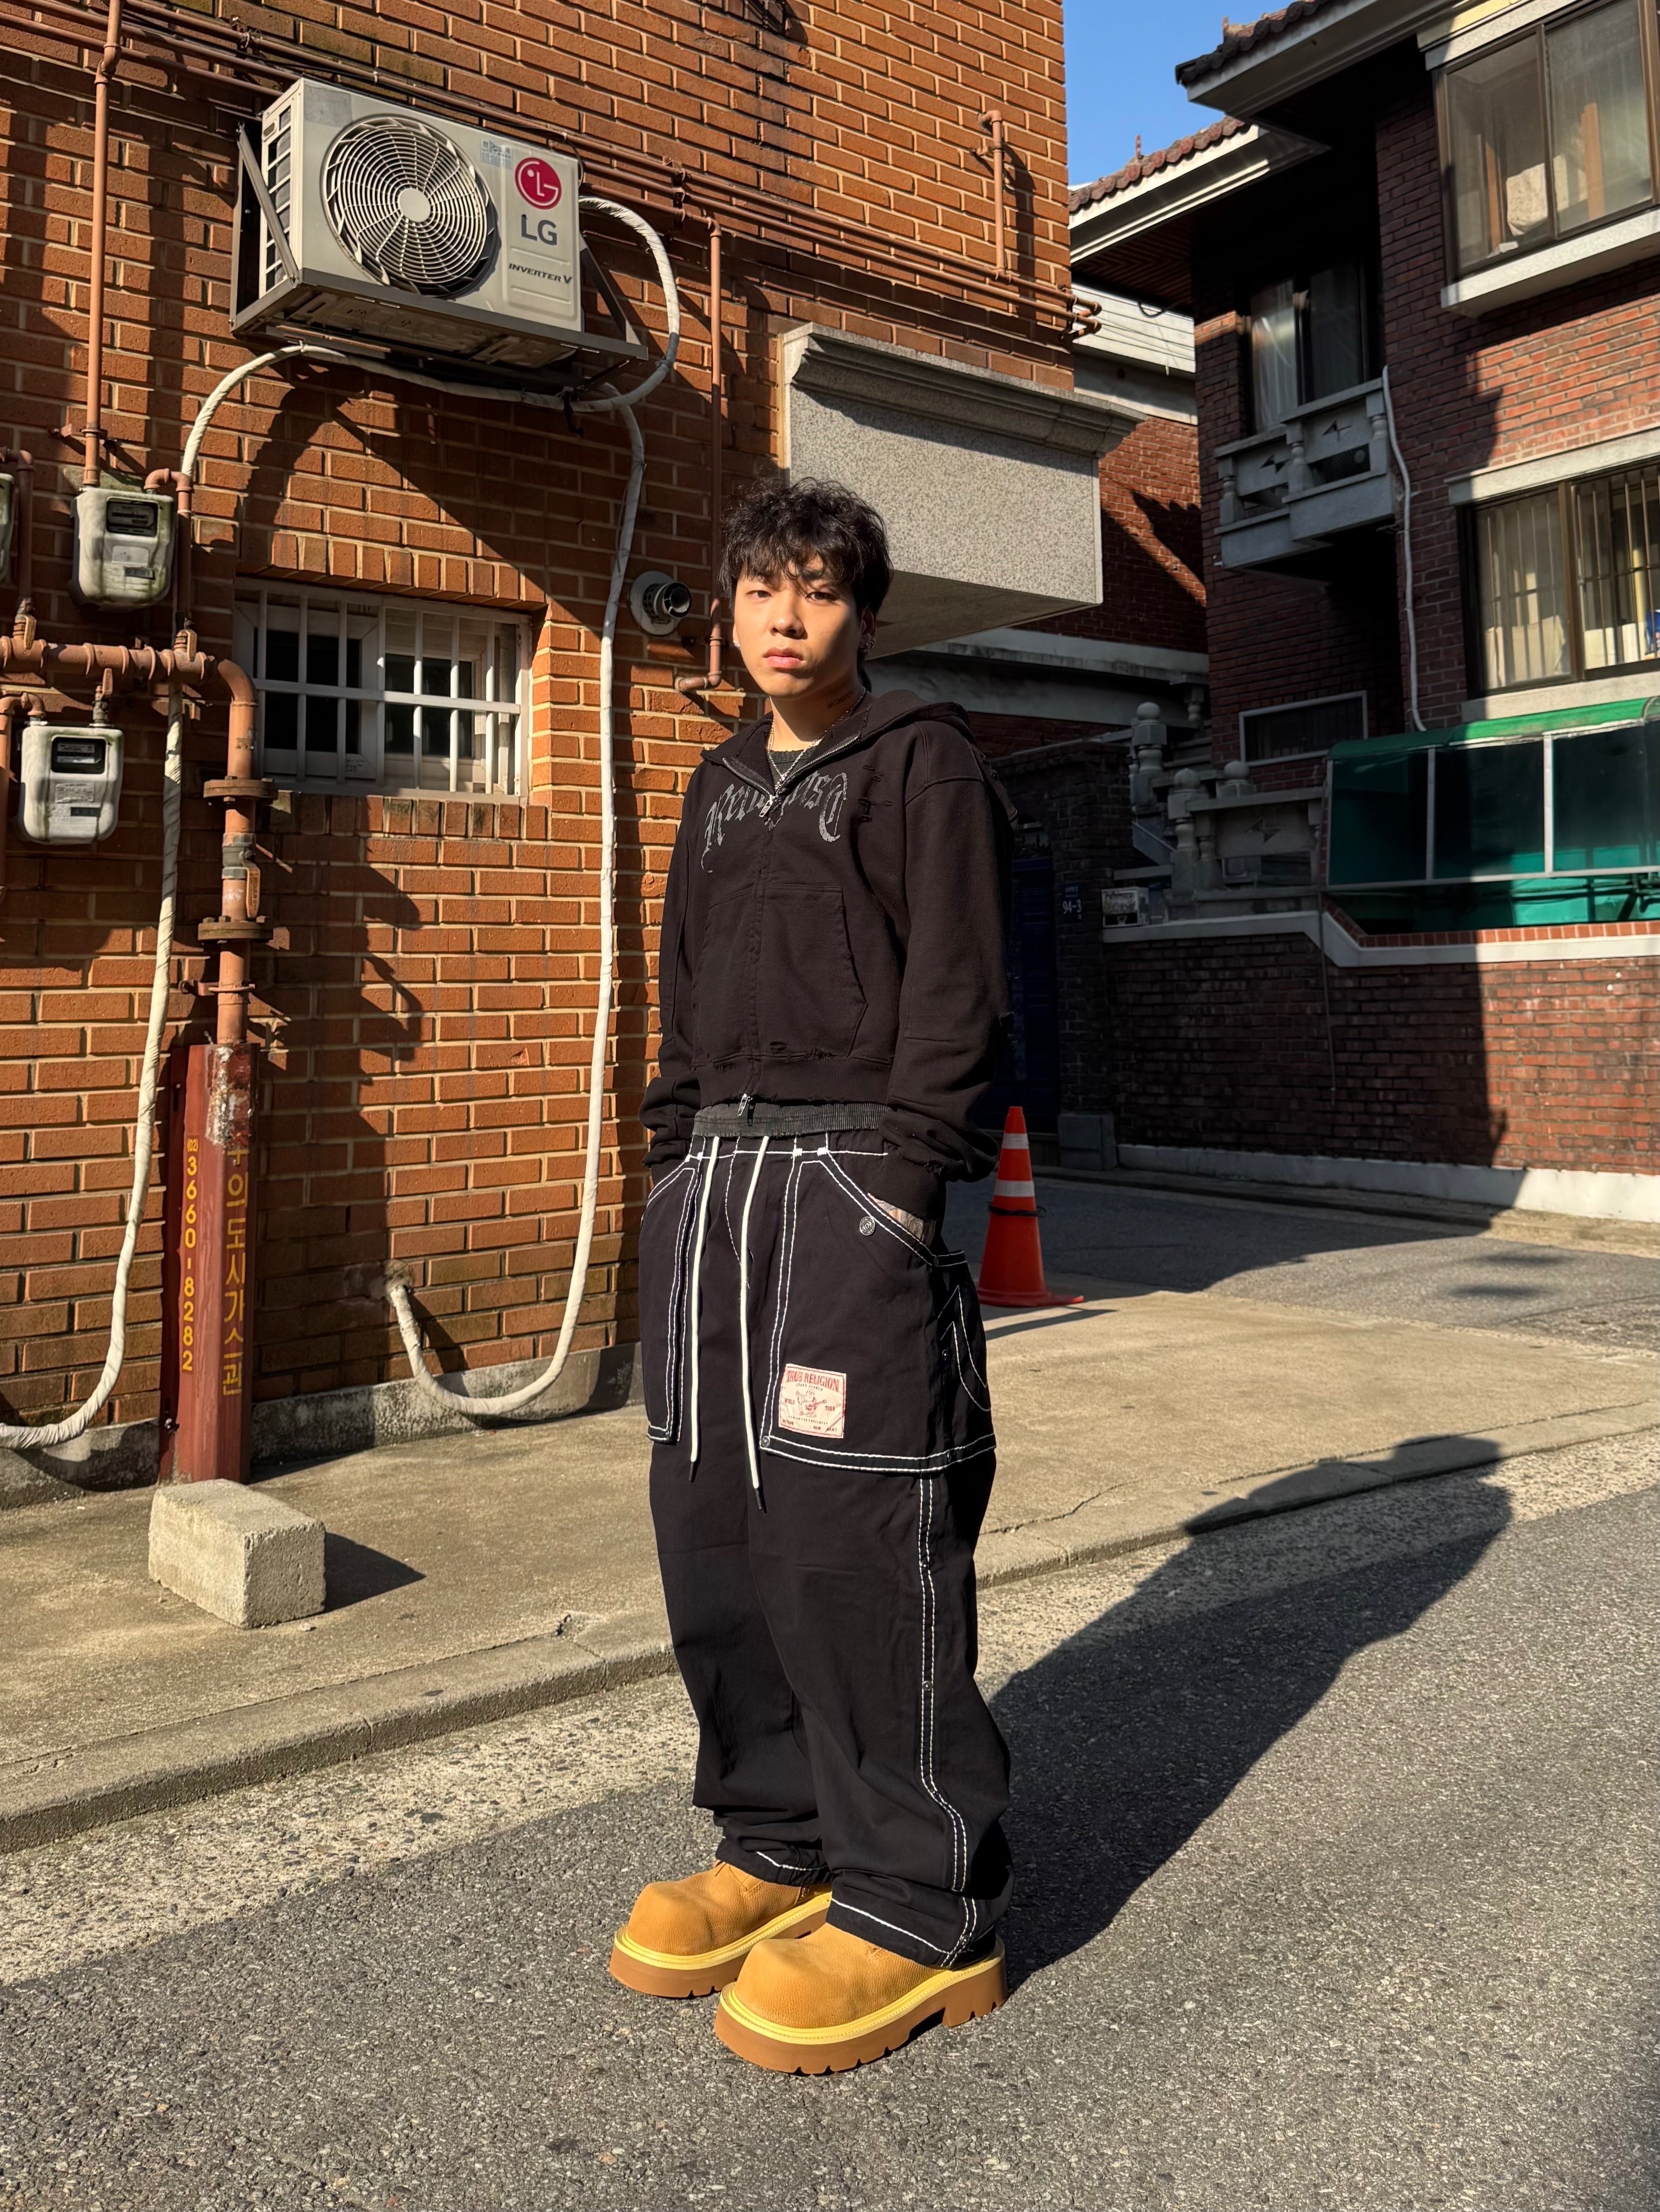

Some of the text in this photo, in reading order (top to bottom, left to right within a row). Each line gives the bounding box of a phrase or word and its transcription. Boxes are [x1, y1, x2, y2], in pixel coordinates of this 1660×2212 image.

[521, 214, 558, 245] LG
[508, 263, 572, 284] INVERTER V
[187, 1138, 198, 1152] (02)
[786, 1370, 803, 1383] TRUE
[804, 1373, 840, 1392] RELIGION
